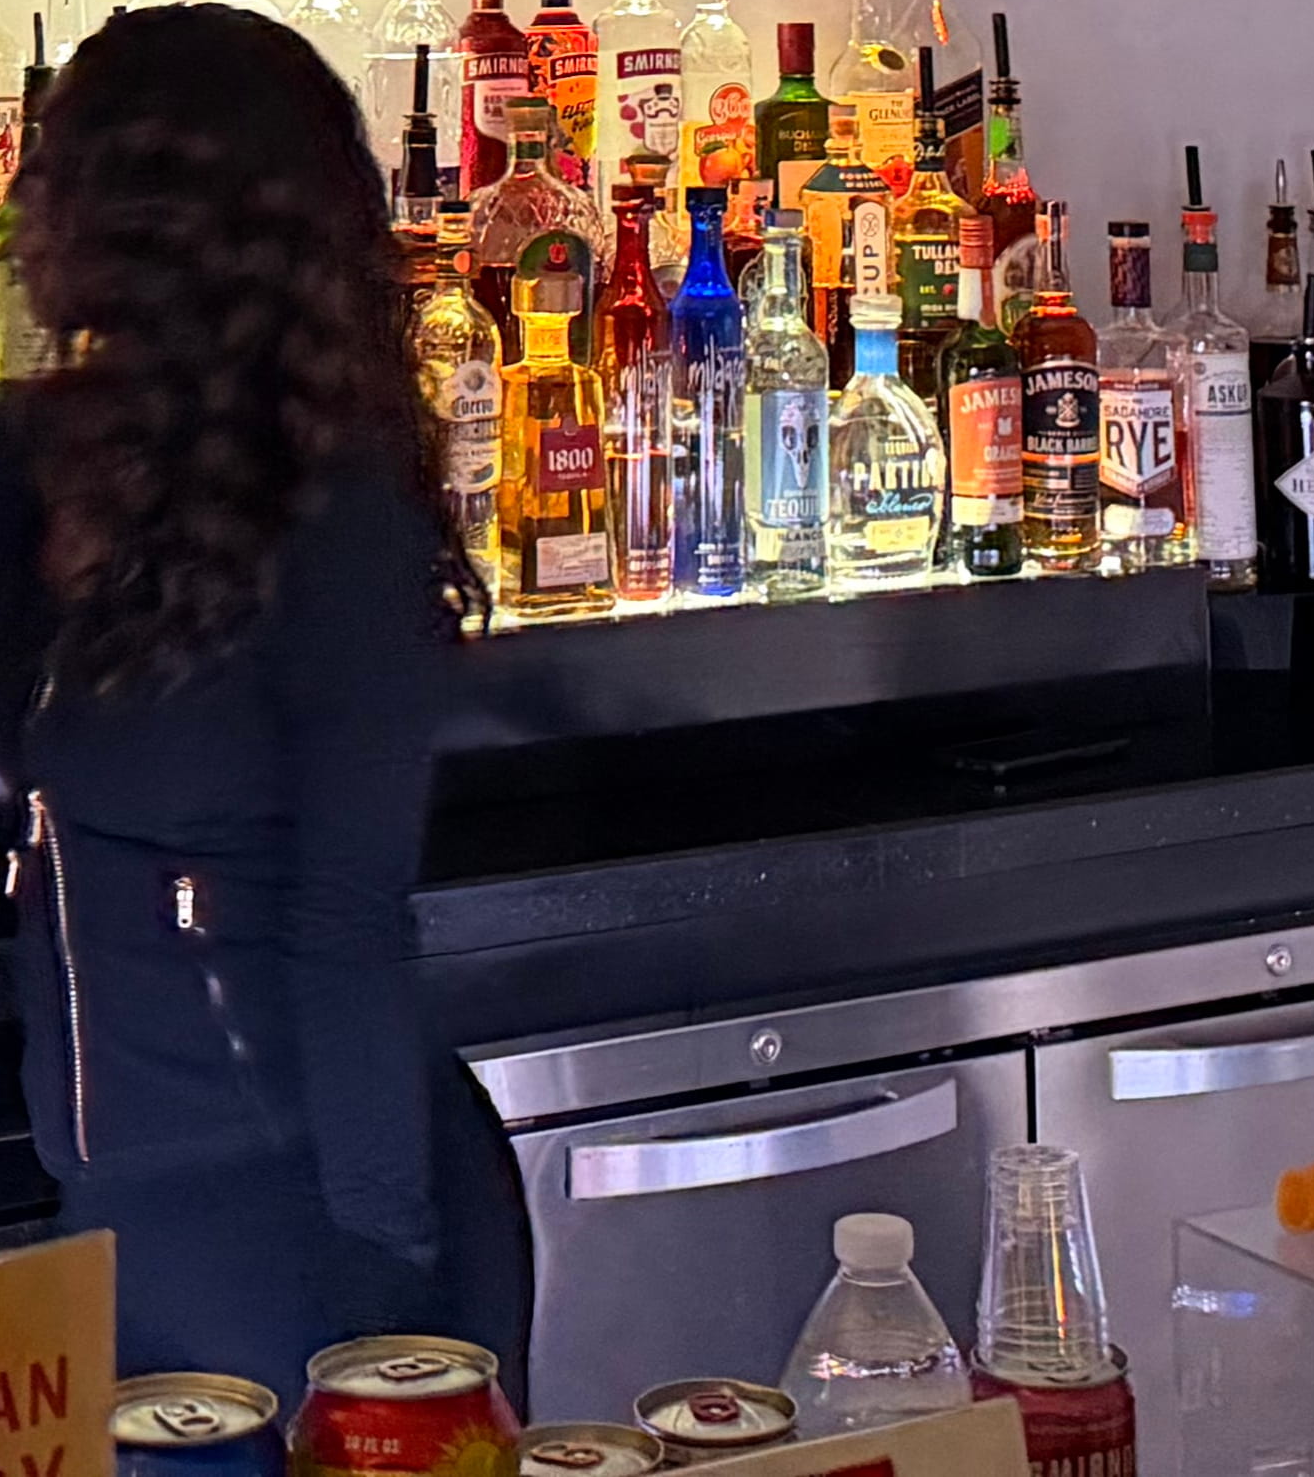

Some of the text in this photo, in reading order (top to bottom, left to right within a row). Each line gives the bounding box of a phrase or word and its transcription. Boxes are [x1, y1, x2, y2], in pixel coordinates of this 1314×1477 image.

[960, 387, 1021, 413] JAMES
[1027, 435, 1065, 453] BLACK
[1105, 420, 1172, 475] RYE
[548, 447, 594, 472] 1800
